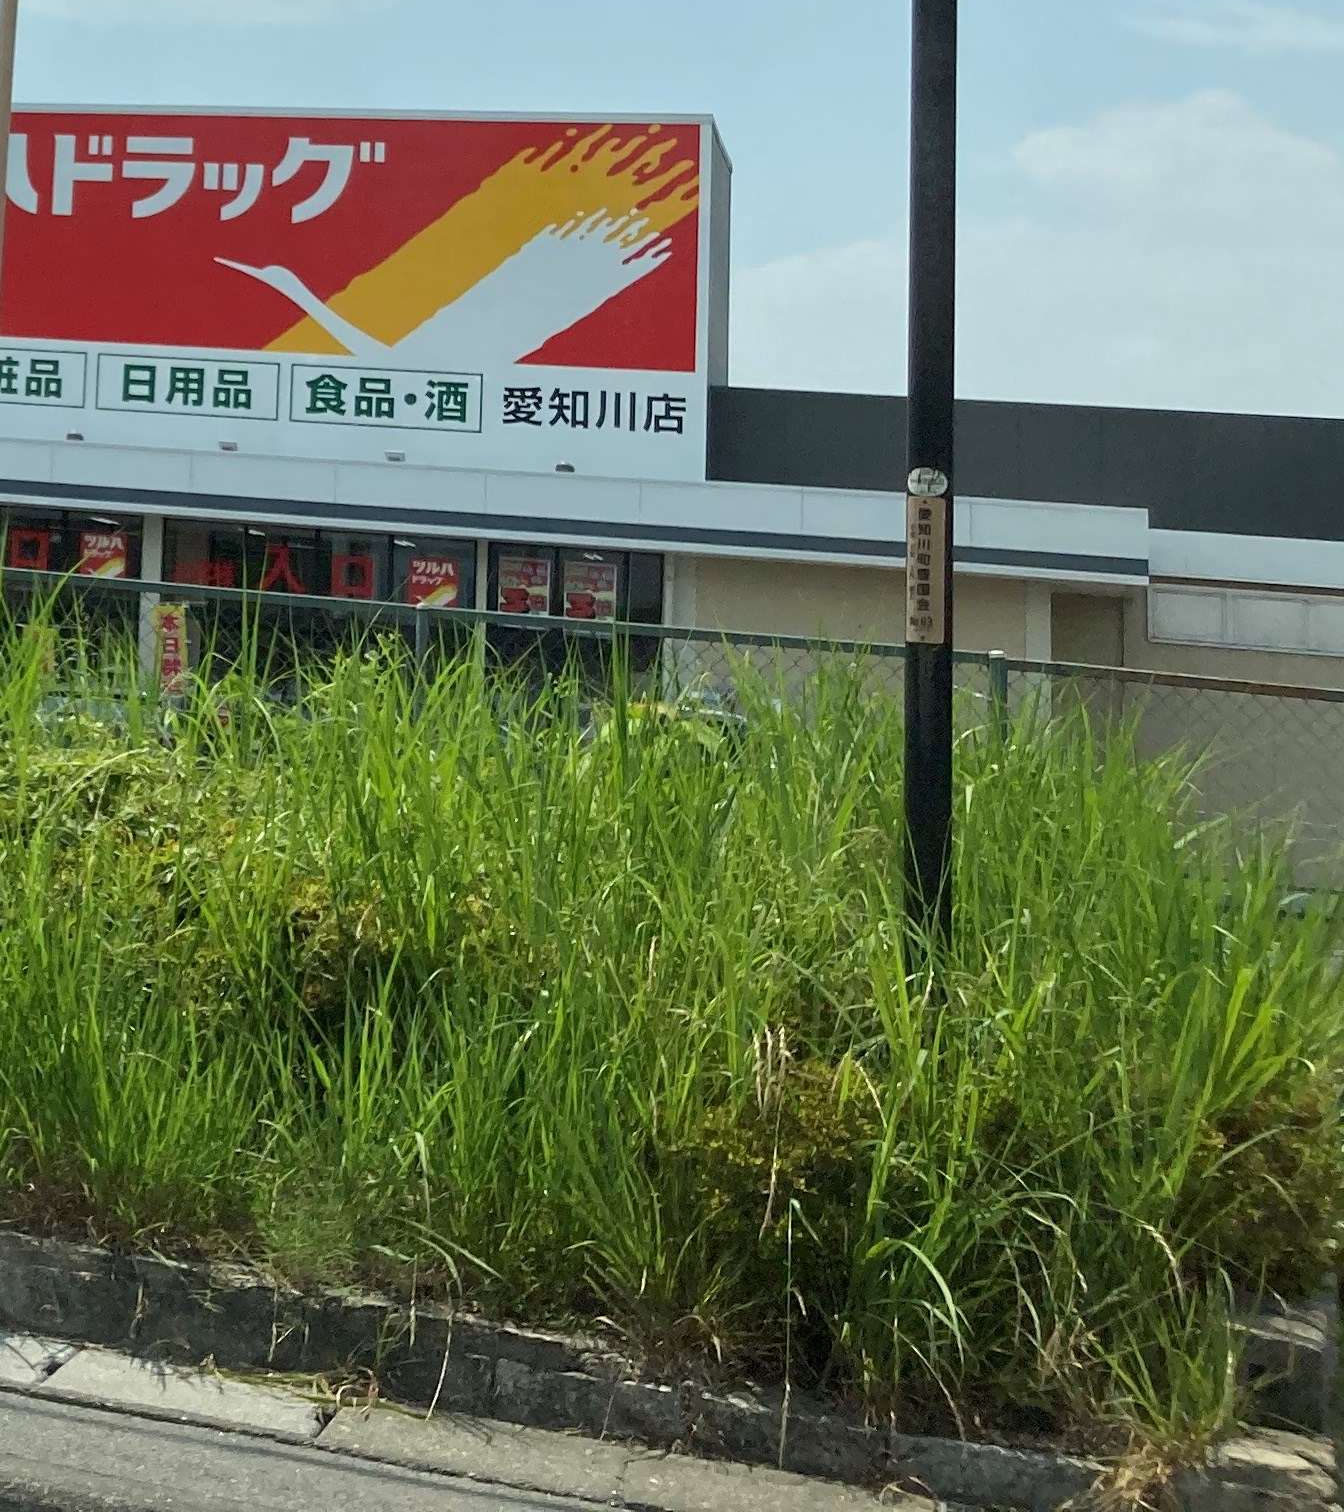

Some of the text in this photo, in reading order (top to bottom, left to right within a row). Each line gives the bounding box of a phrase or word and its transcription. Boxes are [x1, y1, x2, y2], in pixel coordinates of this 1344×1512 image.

[121, 363, 253, 410] 日用品
[502, 386, 688, 435] 愛知川店
